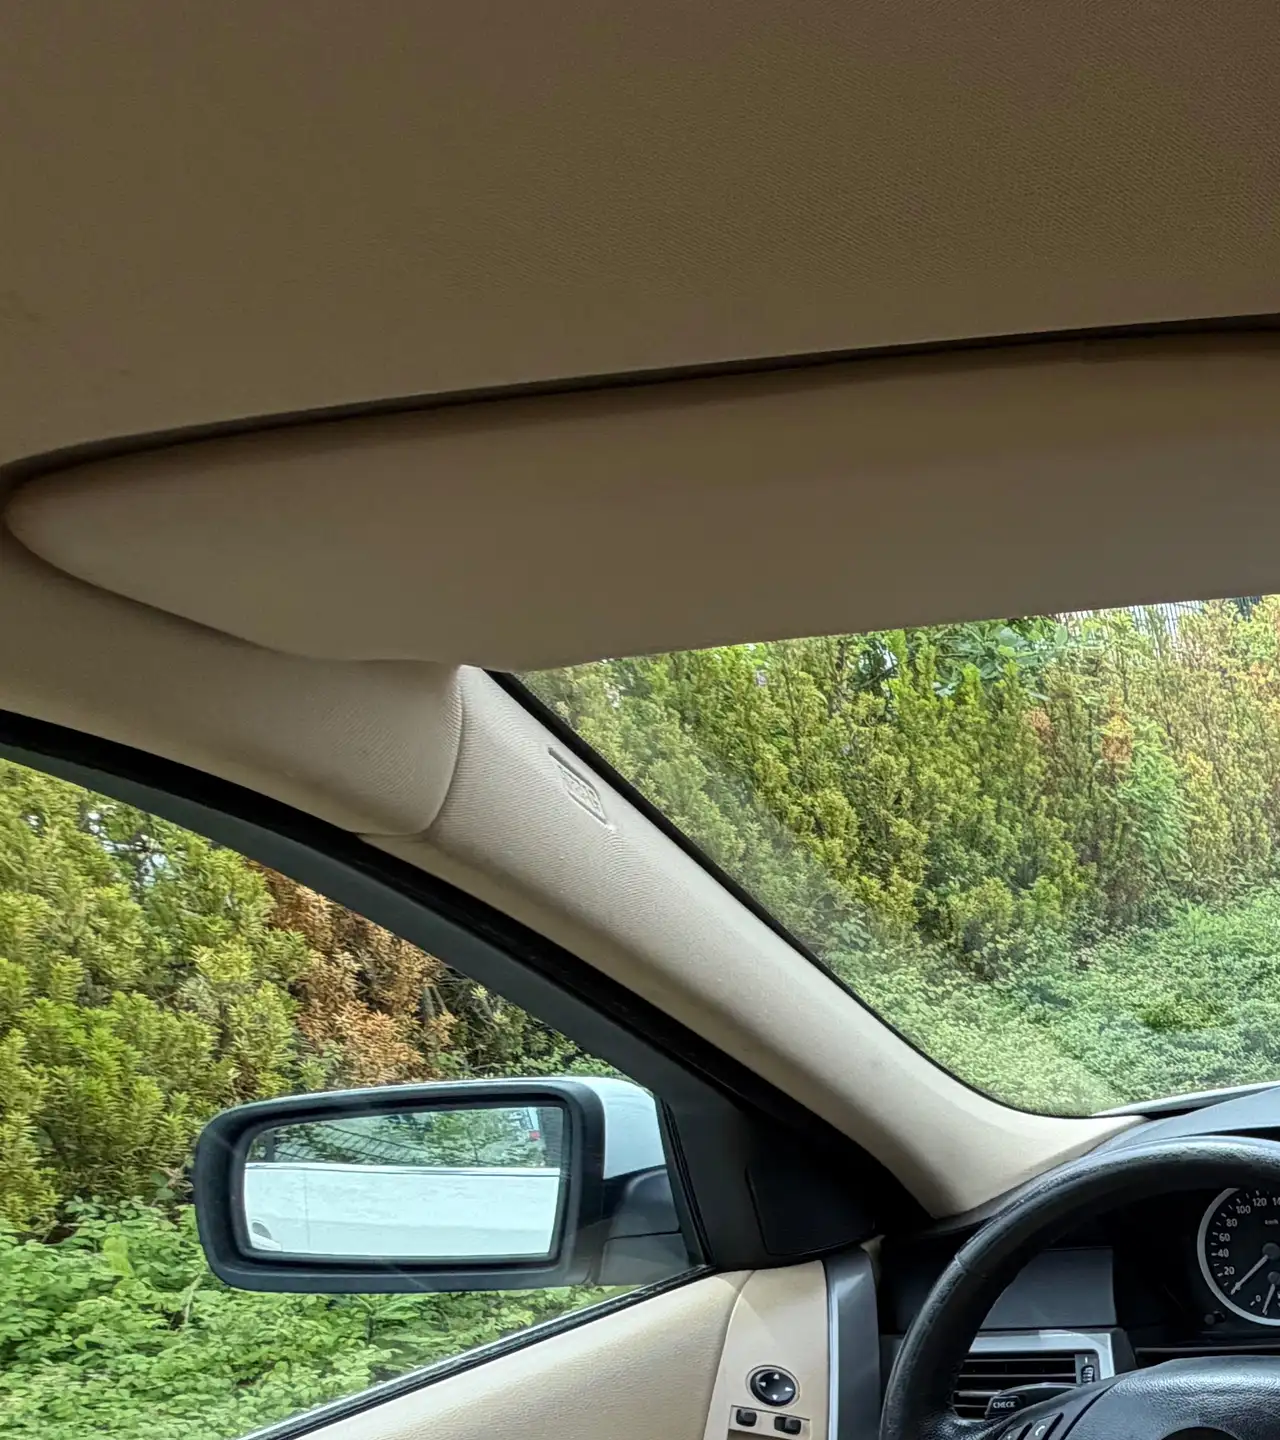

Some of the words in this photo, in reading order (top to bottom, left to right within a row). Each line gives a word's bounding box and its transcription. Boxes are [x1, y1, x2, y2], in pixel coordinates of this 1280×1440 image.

[1252, 1197, 1268, 1207] 120
[1235, 1204, 1252, 1214] 100
[1226, 1218, 1238, 1227] 80
[1218, 1232, 1231, 1242] 60
[1217, 1248, 1229, 1258] 40
[1223, 1265, 1235, 1275] 20
[992, 1401, 1016, 1409] CHECK
